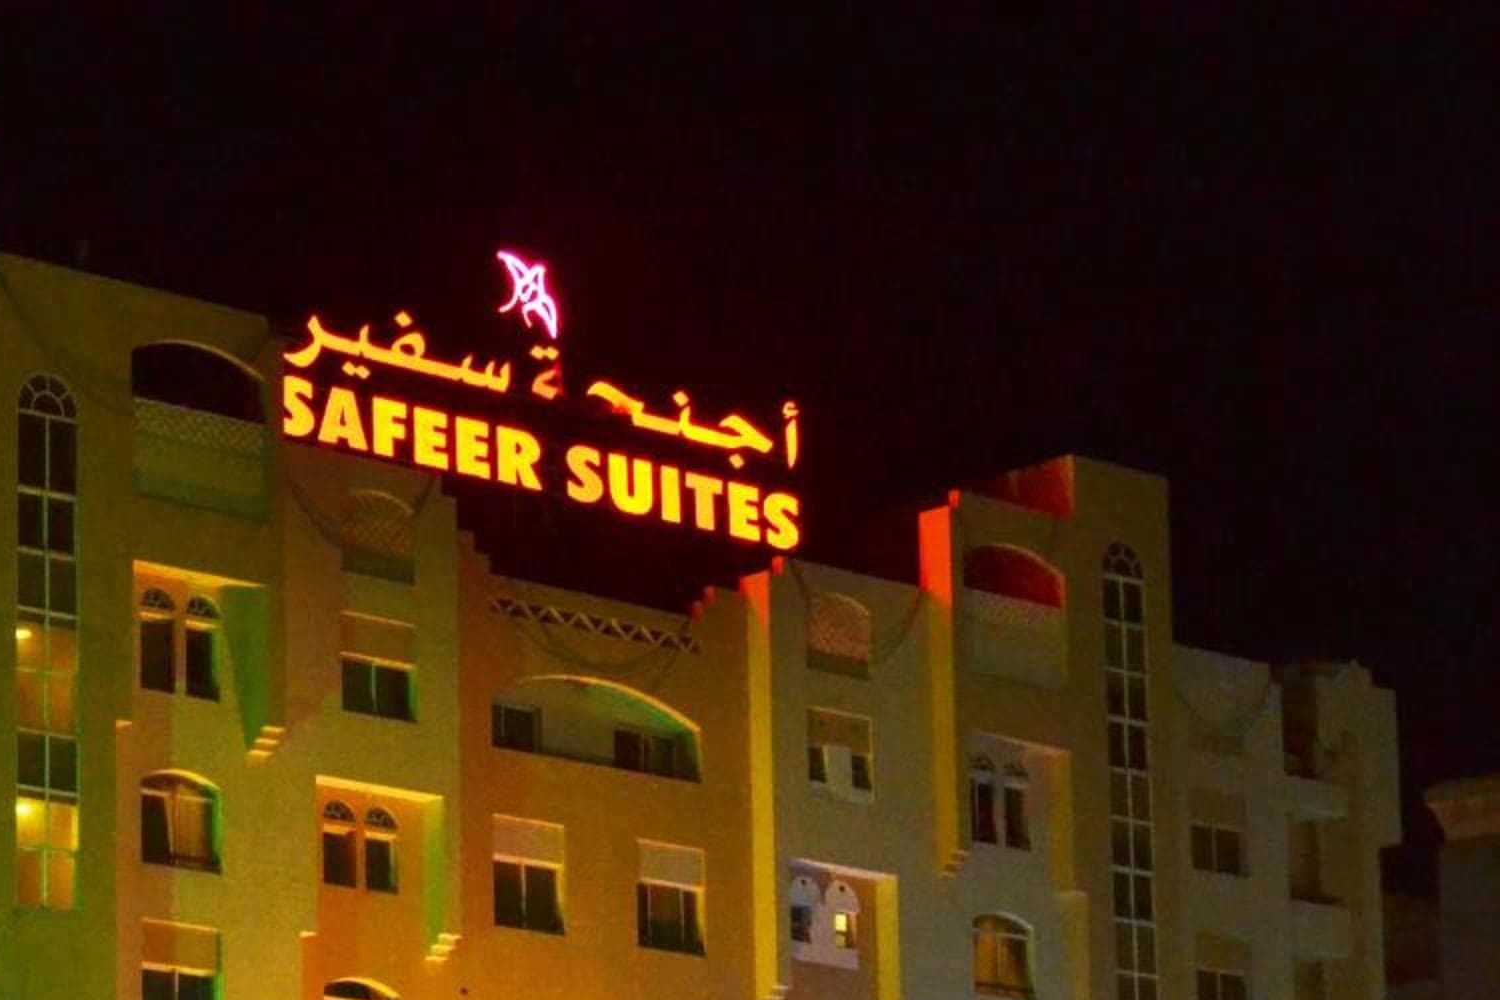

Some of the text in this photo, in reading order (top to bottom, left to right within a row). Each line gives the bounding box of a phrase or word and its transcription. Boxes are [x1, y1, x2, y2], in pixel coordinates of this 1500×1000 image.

[283, 311, 511, 391] سفير
[283, 375, 800, 551] SAFEER SUITES
